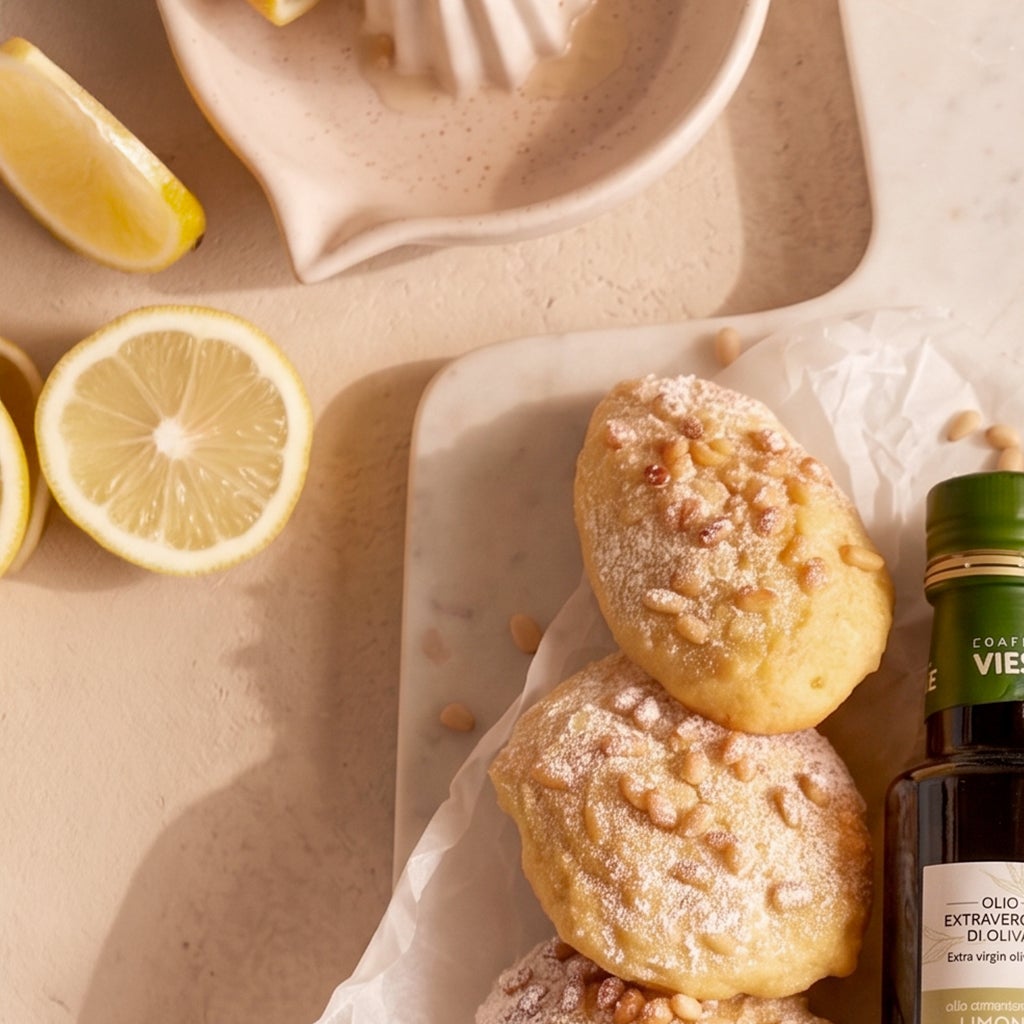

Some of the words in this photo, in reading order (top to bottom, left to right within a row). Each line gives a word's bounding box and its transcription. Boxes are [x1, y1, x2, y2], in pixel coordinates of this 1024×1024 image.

[982, 897, 1018, 909] OLIO
[968, 930, 982, 941] DI
[947, 952, 973, 962] Extra
[976, 952, 1006, 964] virgin
